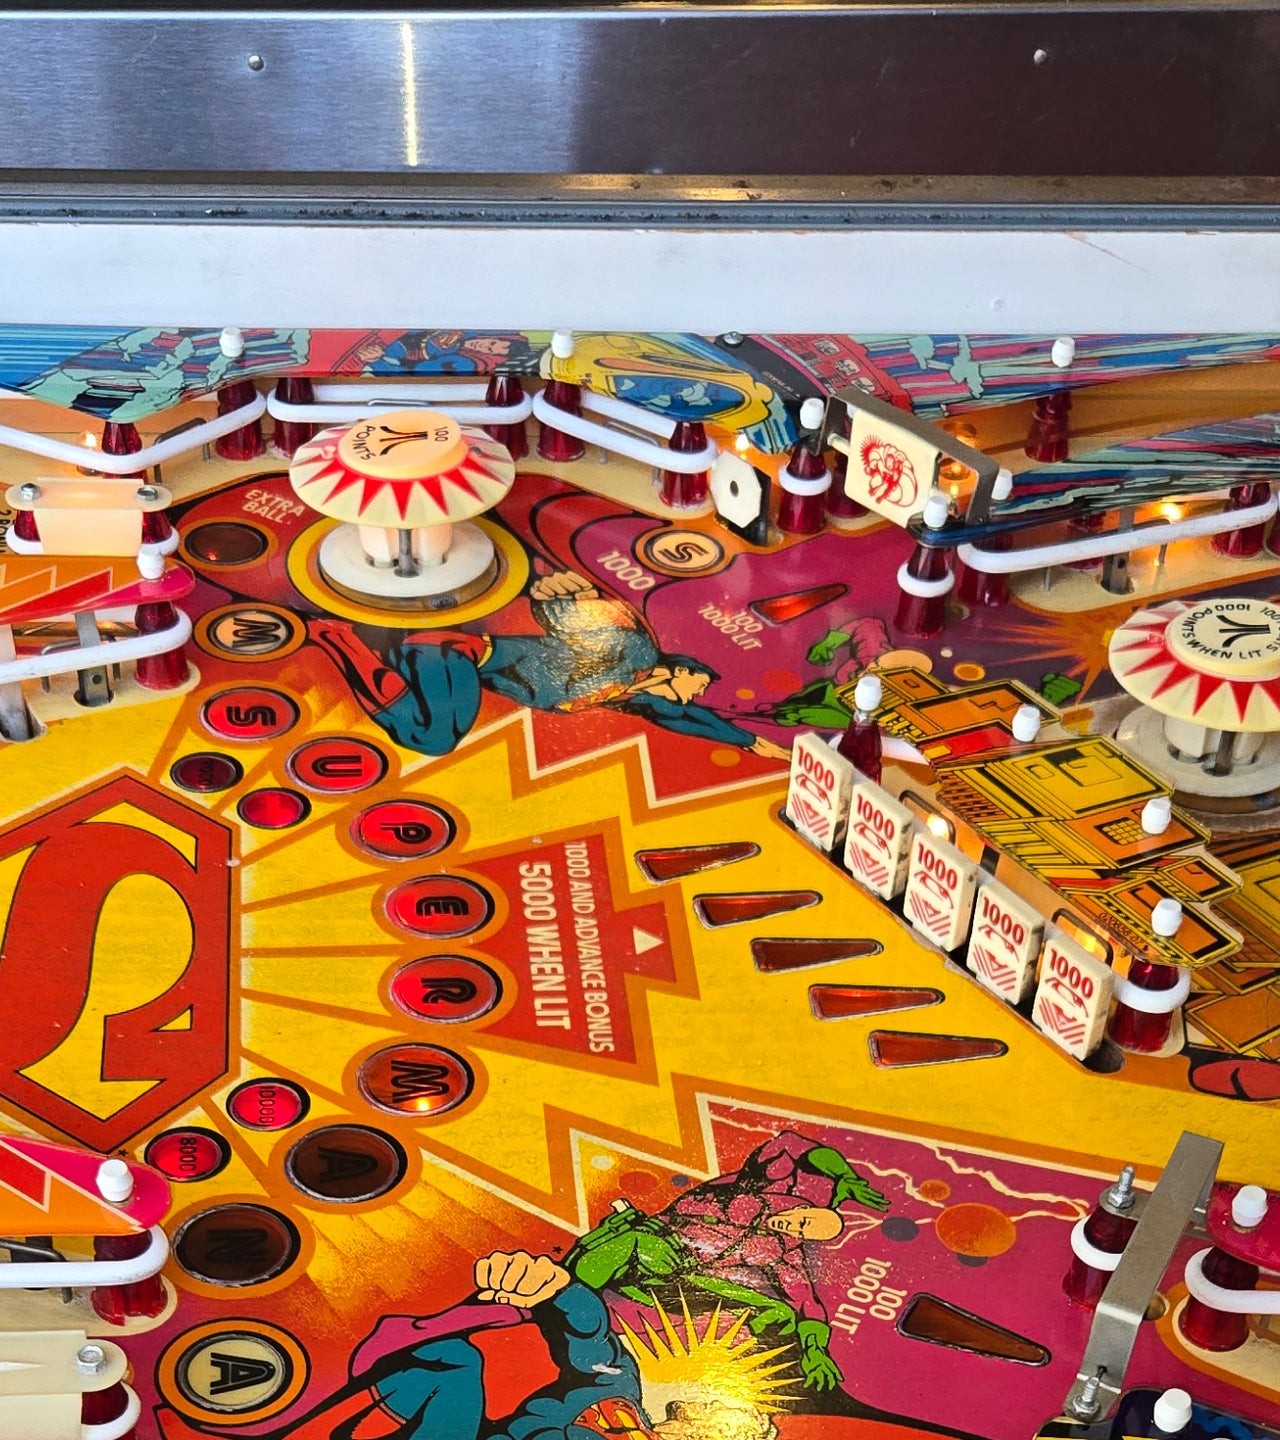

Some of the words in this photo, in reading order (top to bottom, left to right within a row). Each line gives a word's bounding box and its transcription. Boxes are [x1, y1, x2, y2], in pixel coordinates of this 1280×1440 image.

[352, 425, 377, 461] POINTS
[434, 426, 449, 442] 100
[242, 501, 286, 523] BALL
[245, 489, 305, 517] EXTRA
[596, 549, 656, 591] 1000
[657, 541, 709, 563] S
[697, 602, 739, 634] 1000
[731, 631, 763, 651] LIT
[730, 609, 763, 633] 100
[1182, 607, 1212, 638] POINTS
[1187, 639, 1233, 659] WHEN
[1239, 650, 1262, 659] LIT
[797, 745, 835, 792] 1000
[380, 822, 432, 844] P
[857, 794, 896, 841] 1000
[564, 842, 590, 878] 1000
[918, 844, 957, 891] 1000
[518, 861, 557, 921] 5000
[569, 881, 595, 914] AND
[982, 897, 1024, 945] 1000
[525, 924, 567, 991] WHEN
[573, 917, 606, 989] ADVANCE
[1050, 949, 1094, 1000] 1000
[533, 997, 571, 1030] LIT
[583, 989, 615, 1053] BONUS
[258, 1085, 275, 1127] 10000
[847, 1257, 892, 1307] 1000
[830, 1303, 867, 1335] LIT
[869, 1286, 908, 1321] 100
[210, 1352, 276, 1395] A
